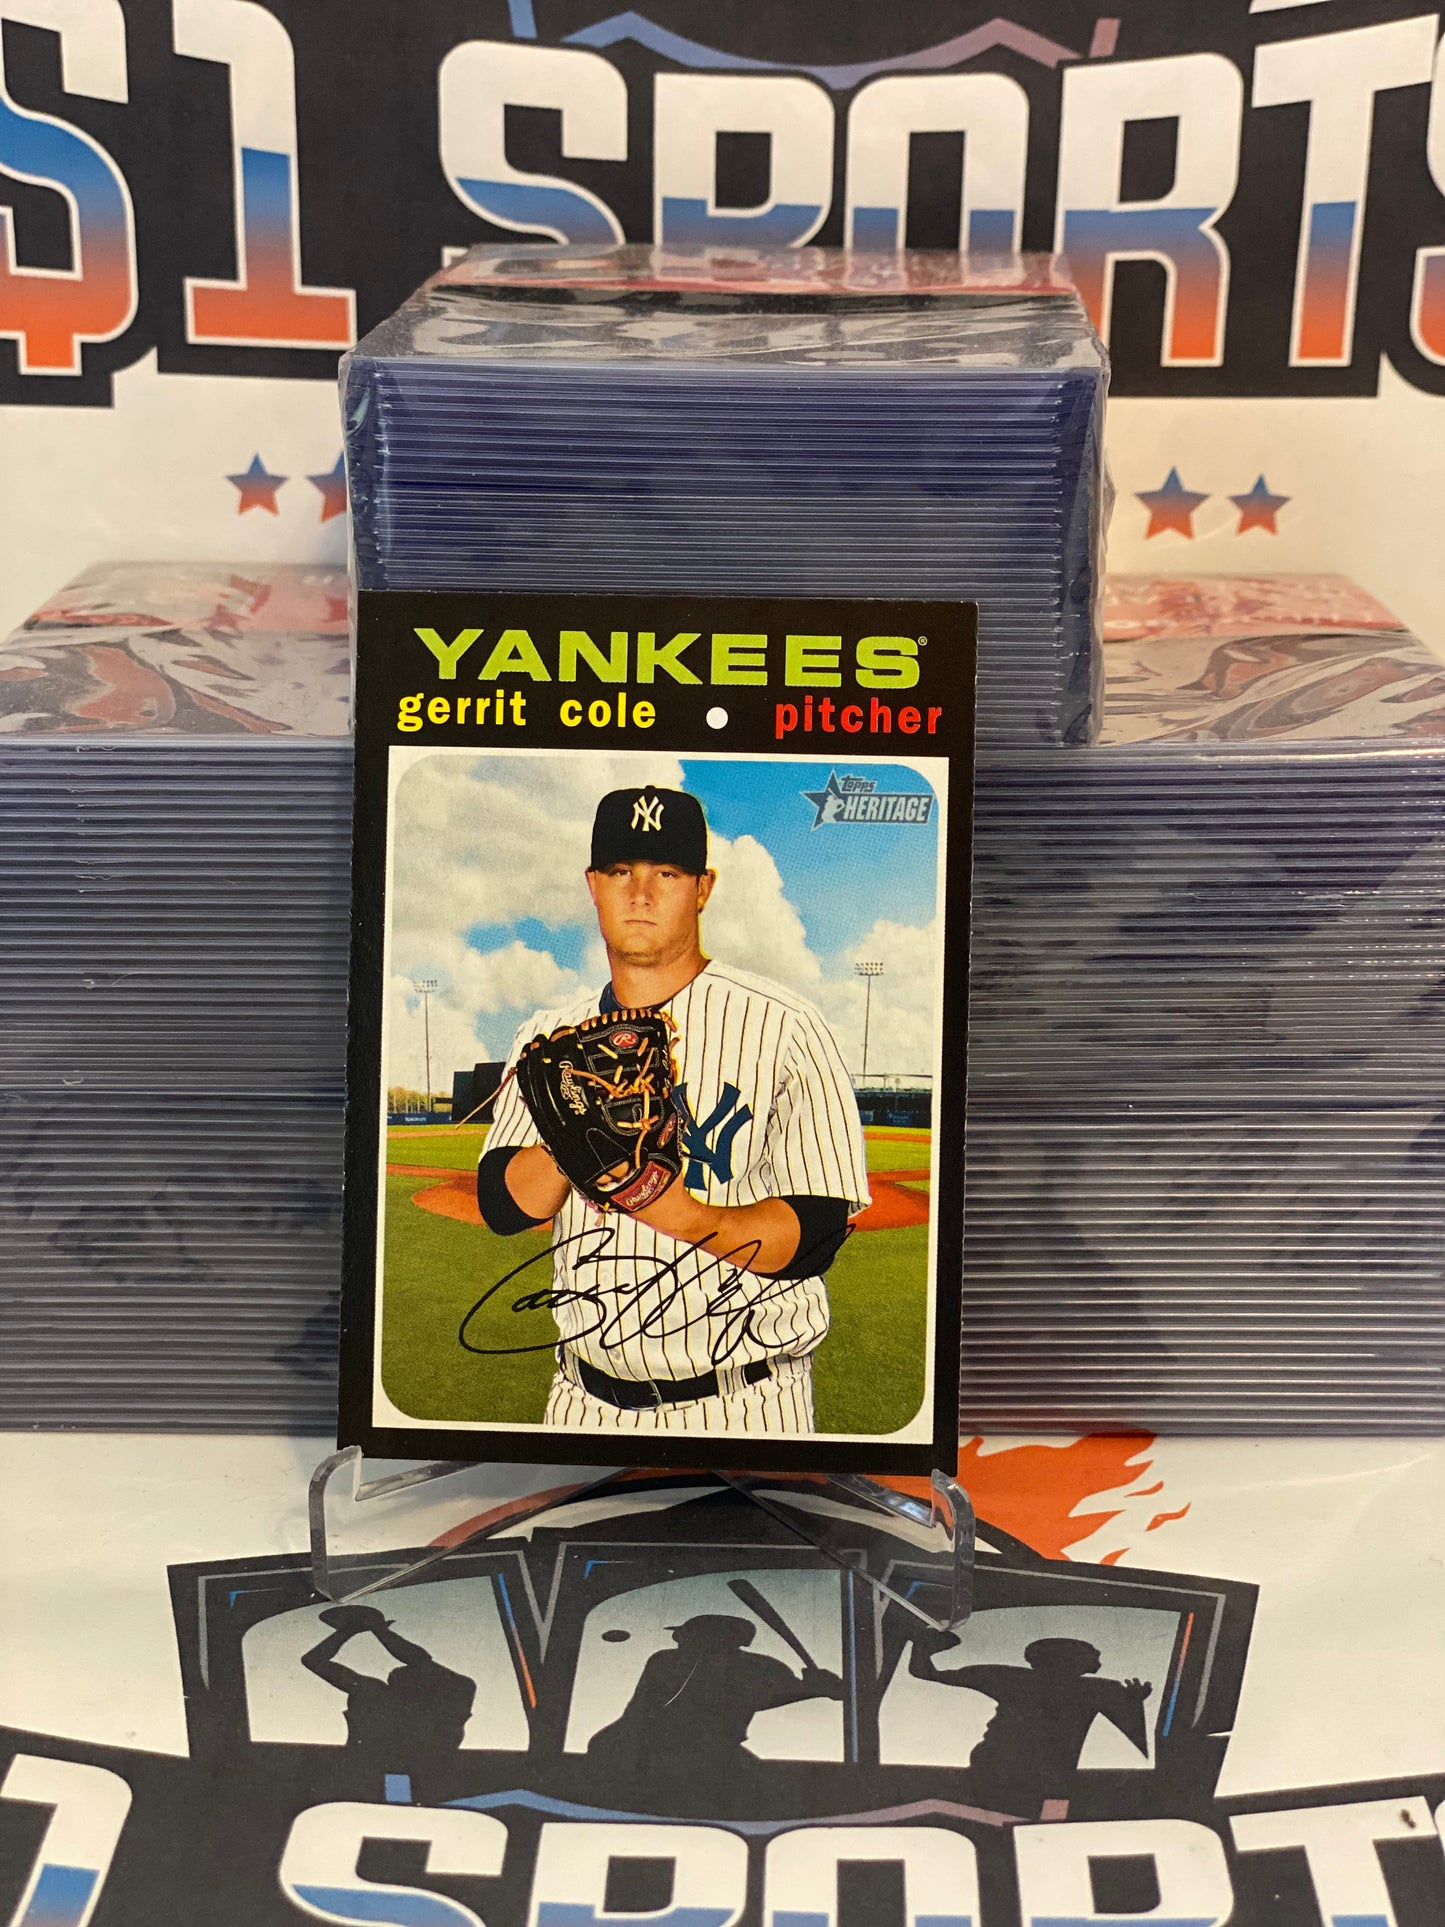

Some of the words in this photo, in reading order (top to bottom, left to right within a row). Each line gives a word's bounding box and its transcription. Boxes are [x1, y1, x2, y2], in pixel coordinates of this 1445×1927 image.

[438, 14, 1445, 367] SPORT
[397, 689, 527, 732] gerrit
[559, 692, 656, 728] cole
[775, 695, 942, 739] pitcher
[843, 795, 930, 821] HERITAGE
